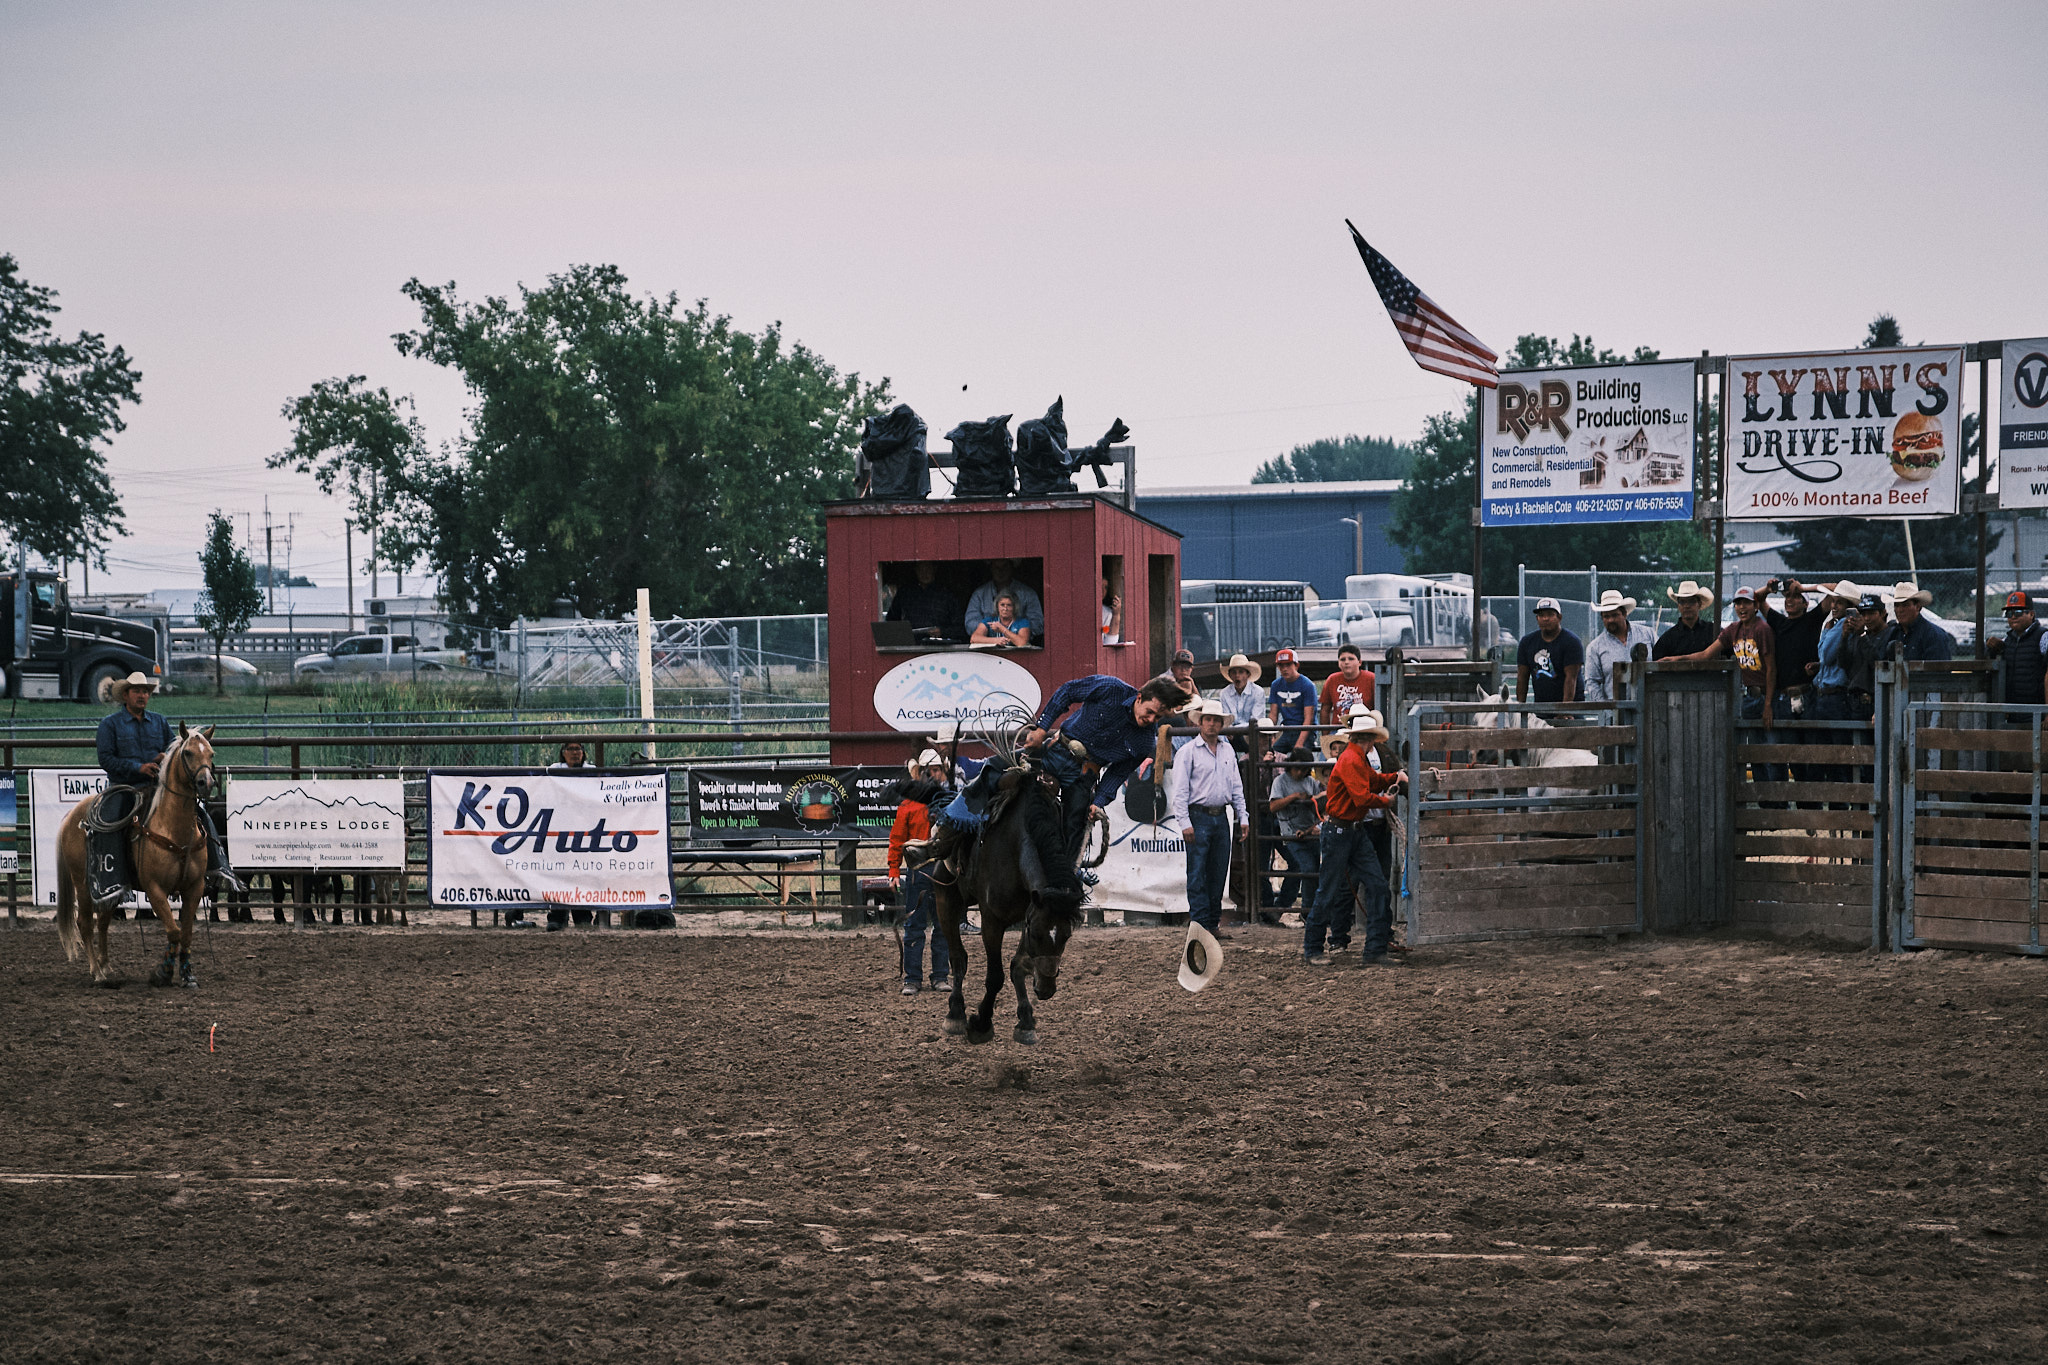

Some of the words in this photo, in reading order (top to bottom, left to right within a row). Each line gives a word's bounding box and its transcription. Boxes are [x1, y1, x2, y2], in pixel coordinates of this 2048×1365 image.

[1577, 378, 1641, 403] Building
[1741, 362, 1949, 423] LYNN'S
[1497, 379, 1573, 444] R&R
[1577, 405, 1671, 429] Productions
[1673, 413, 1688, 425] LLC
[1492, 446, 1511, 458] New
[1513, 444, 1568, 457] Construction,
[1740, 426, 1887, 470] DRIVE-IN
[1492, 461, 1544, 474] Commercial,
[1546, 458, 1594, 471] Residential
[2011, 466, 2032, 474] Ronan
[1492, 479, 1508, 490] and
[1510, 477, 1551, 489] Remodels
[1750, 492, 1799, 508] 100%
[1803, 491, 1882, 506] Montana
[1888, 488, 1929, 504] Beef
[1491, 503, 1513, 518] Rocky
[1515, 503, 1521, 515] &
[1522, 502, 1553, 515] Rachelle
[1554, 502, 1572, 513] Cote
[1575, 499, 1623, 513] 406-212-0357
[1625, 502, 1633, 511] or
[1634, 497, 1684, 511] 406-676-5554
[897, 708, 950, 719] Access
[955, 707, 1021, 718] Montana
[600, 779, 632, 793] Locally
[634, 778, 664, 790] Owned
[806, 773, 839, 788] TIMBERS
[698, 781, 725, 796] Specialty
[726, 782, 737, 793] cut
[737, 781, 755, 794] wood
[756, 781, 782, 796] products
[453, 781, 531, 830] K-O
[603, 793, 613, 803] &
[615, 791, 657, 806] Operated
[700, 798, 720, 813] Rough
[729, 798, 755, 811] finished
[756, 798, 780, 811] lumber
[701, 815, 717, 830] Open
[719, 817, 726, 827] to
[727, 815, 738, 827] the
[740, 815, 760, 830] public
[491, 808, 639, 855] Auto
[1131, 838, 1186, 853] Mountain
[251, 853, 276, 862] Lodging
[284, 853, 311, 862] Catering
[319, 853, 352, 861] Restaurant
[361, 853, 384, 862] Lounge
[505, 859, 565, 871] Premium
[572, 859, 603, 871] Auto
[609, 858, 655, 872] Repair
[440, 887, 531, 902] 406.676.AUTO
[542, 887, 646, 903] www.k-oauto.com
